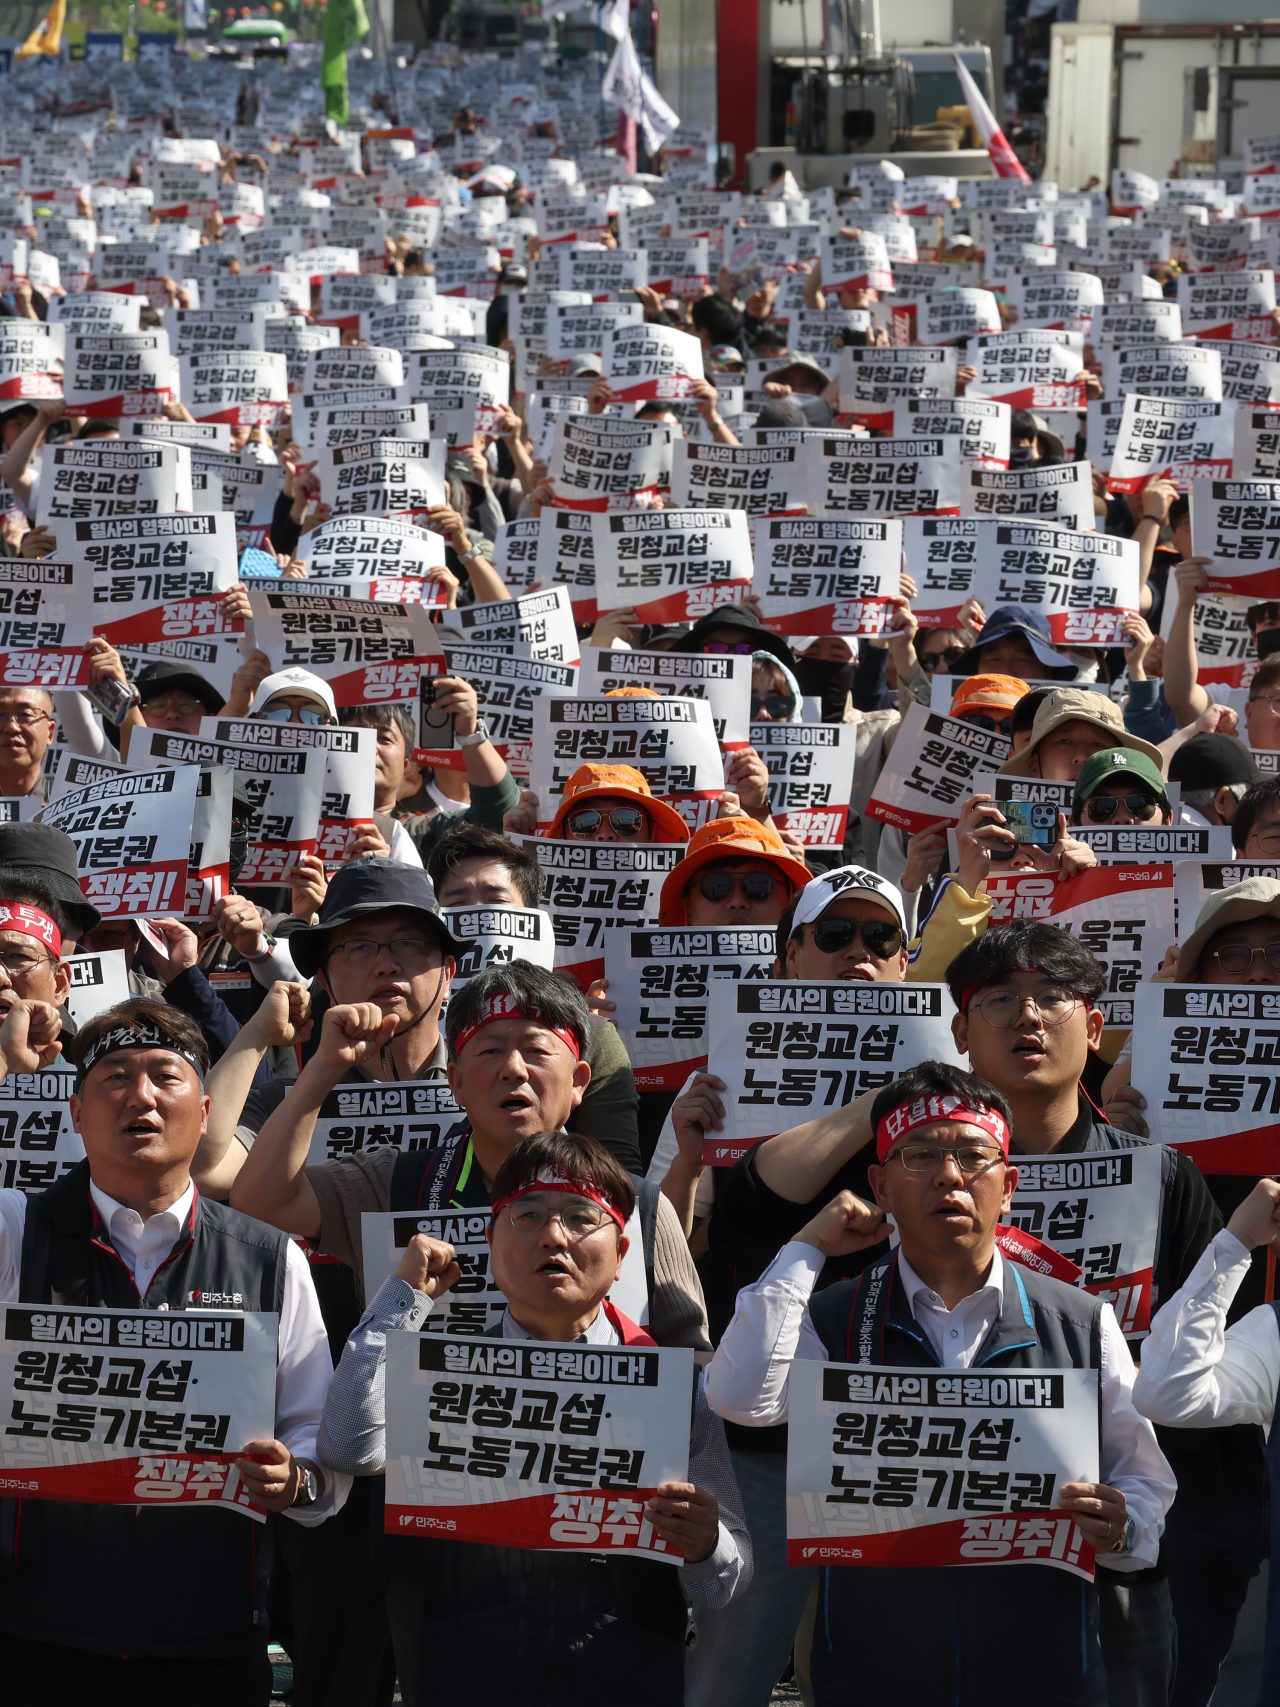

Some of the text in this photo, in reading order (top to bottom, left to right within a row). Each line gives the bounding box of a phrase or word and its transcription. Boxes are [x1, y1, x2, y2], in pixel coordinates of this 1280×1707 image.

[834, 439, 939, 457] 열사의 염원이다!
[824, 486, 940, 512] 노동기본권
[90, 516, 210, 539] 열사의 염원이다!
[621, 511, 726, 530] 열사의 염원이다!
[780, 522, 883, 540] 열사의 염원이다!
[1009, 527, 1119, 557] 열사의 염원이다!
[616, 560, 732, 588] 노동기본권
[765, 573, 881, 599] 노동기본권
[283, 593, 400, 617] 열사의 염원이다!
[996, 579, 1119, 609] 노동기본권
[281, 638, 416, 666] 노동기본권
[3, 651, 81, 686] 쟁취!
[763, 725, 834, 746] 염원이다!
[783, 812, 840, 845] 쟁취!
[84, 872, 179, 914] 쟁취!
[15, 906, 54, 943] 투쟁
[759, 988, 931, 1016] 열사의 염원이다!
[1185, 992, 1255, 1018] 열사의
[202, 1292, 242, 1303] 민주노총
[30, 1314, 232, 1348] 열사의 염원이다!
[444, 1344, 646, 1383] 열사의 염원이다!
[847, 1375, 1051, 1406] 열사의 염원이다!
[5, 1400, 230, 1454] 노동기본권
[423, 1432, 645, 1490] 노동기본권
[826, 1465, 1056, 1513] 노동기본권
[416, 1517, 456, 1531] 민주노총
[820, 1548, 862, 1558] 민주노총
[960, 1519, 1084, 1564] 쟁취!
